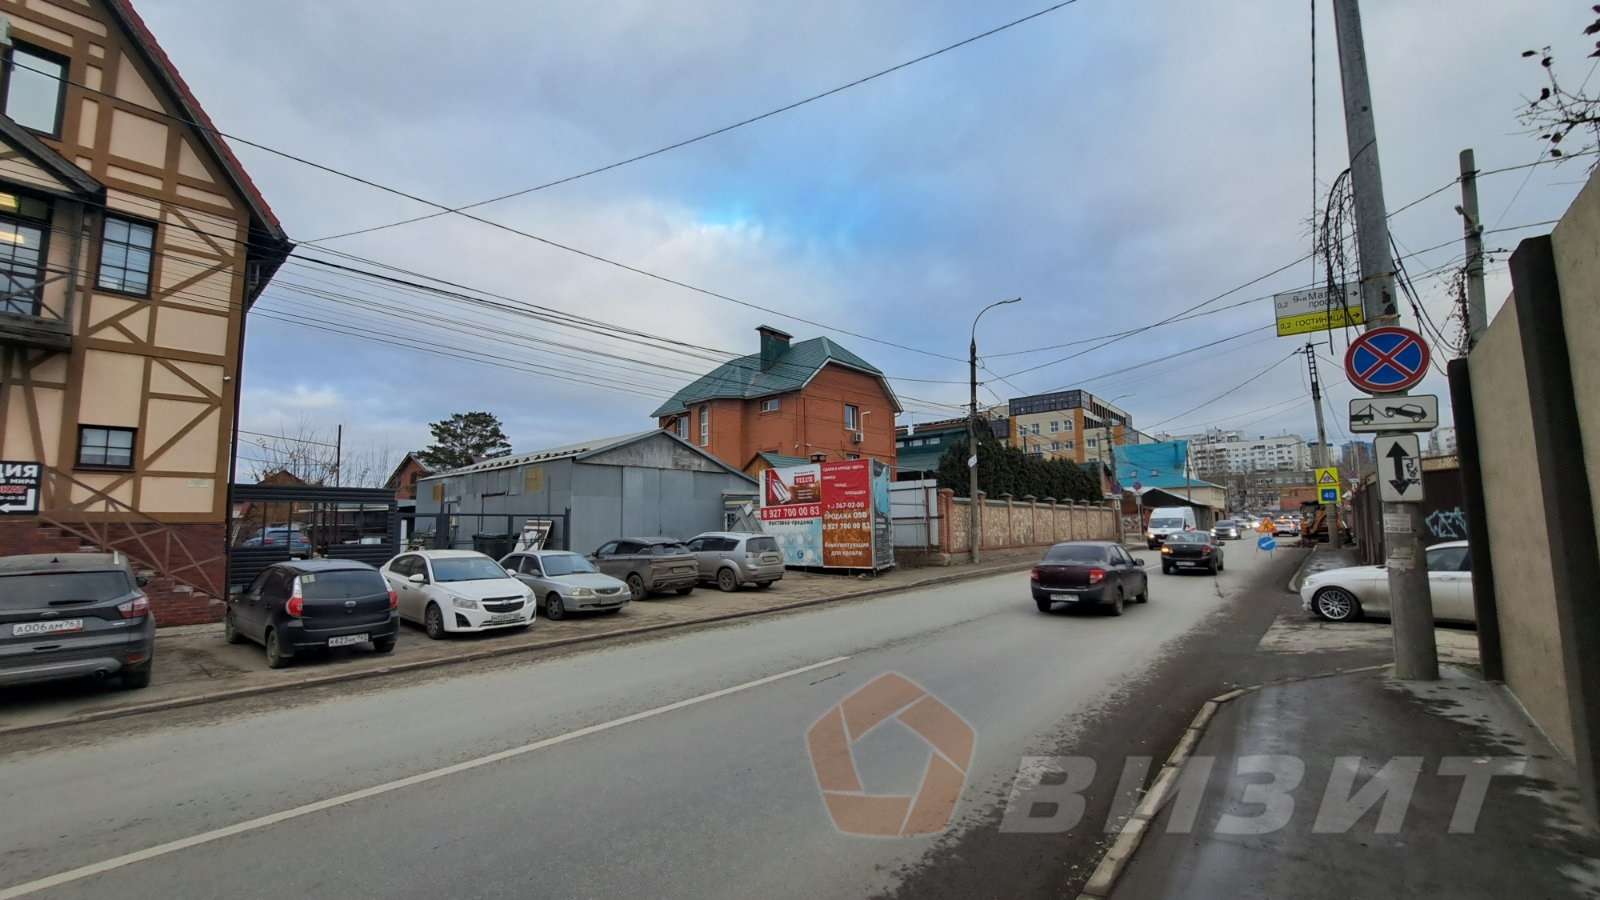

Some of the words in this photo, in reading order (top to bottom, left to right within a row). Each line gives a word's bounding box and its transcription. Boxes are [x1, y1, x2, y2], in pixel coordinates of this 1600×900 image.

[769, 509, 781, 518] 927
[783, 507, 797, 517] 700
[798, 506, 808, 516] 00
[809, 505, 820, 516] 83
